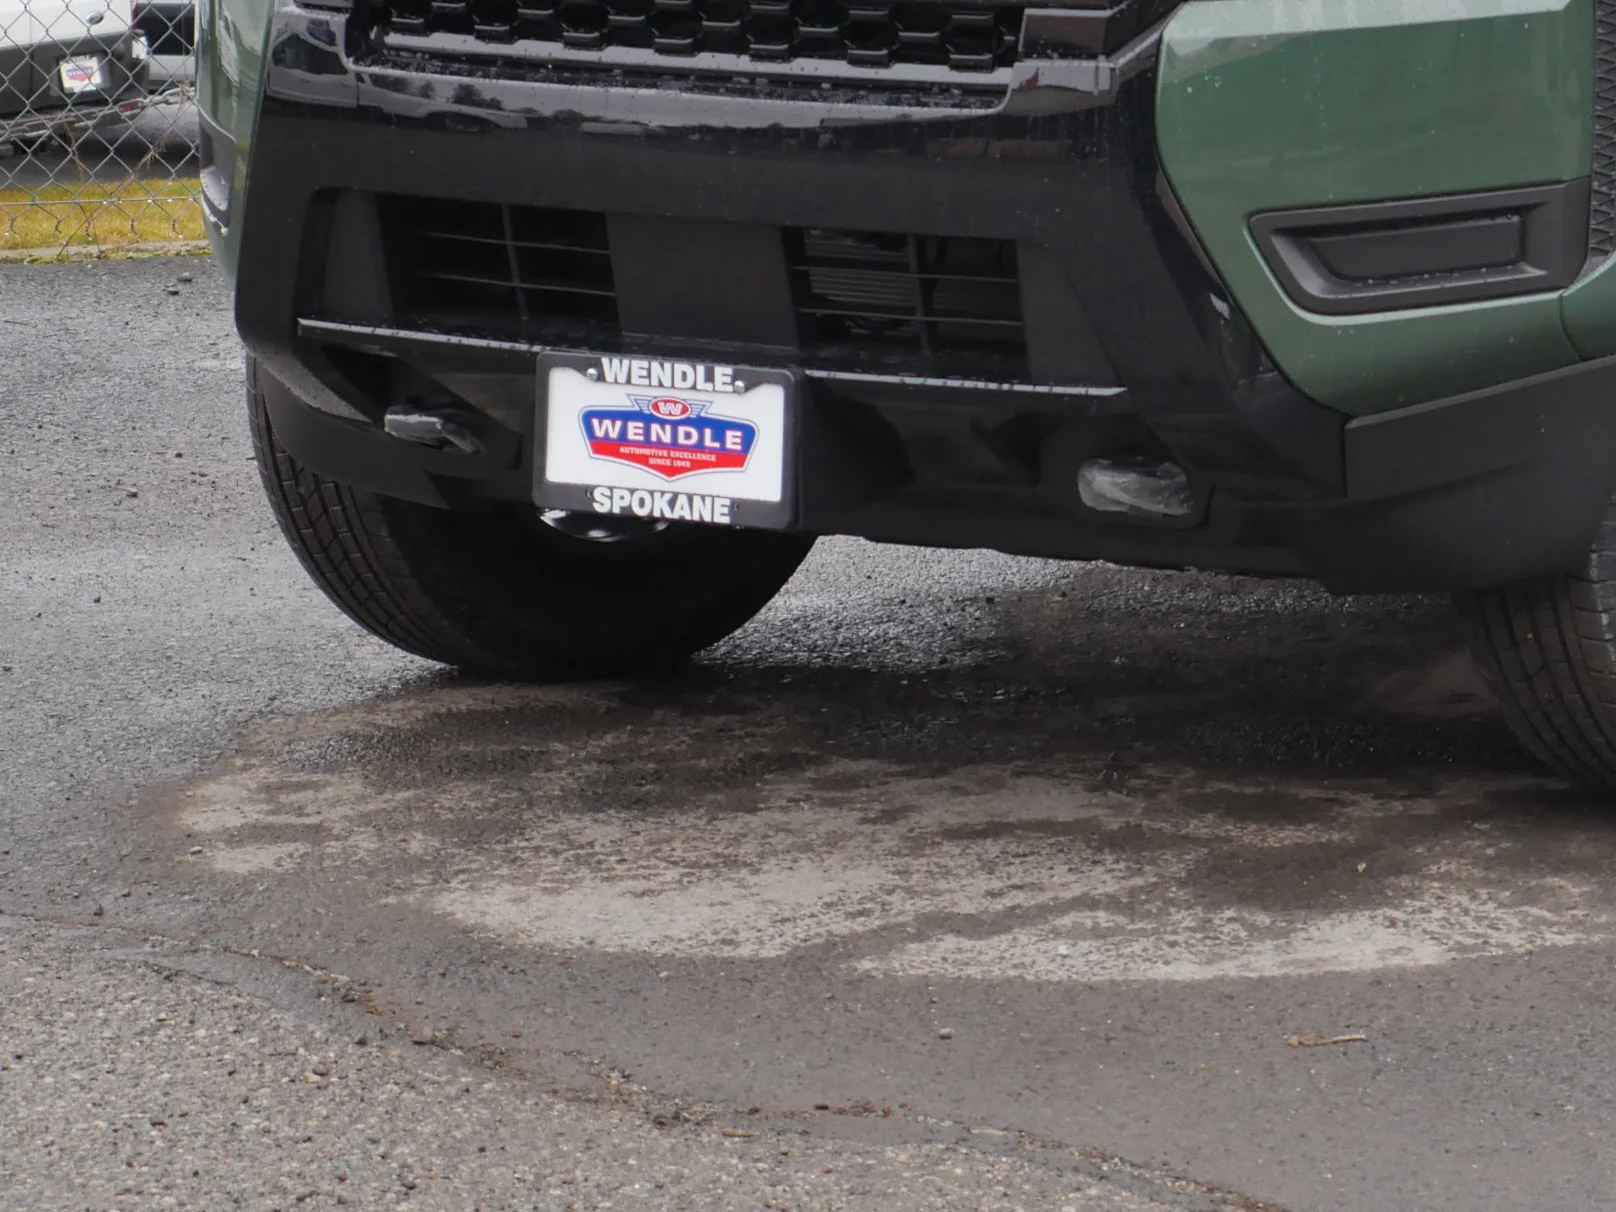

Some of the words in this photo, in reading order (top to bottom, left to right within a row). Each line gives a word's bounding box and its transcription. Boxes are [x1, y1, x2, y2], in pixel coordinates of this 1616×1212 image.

[601, 358, 734, 392] WENDLE
[590, 418, 743, 450] WENDLE
[619, 445, 668, 458] AUTOMOTIVE
[670, 450, 717, 462] EXCELLENCE
[648, 457, 671, 466] SINCE
[592, 487, 731, 525] SPOKANE
